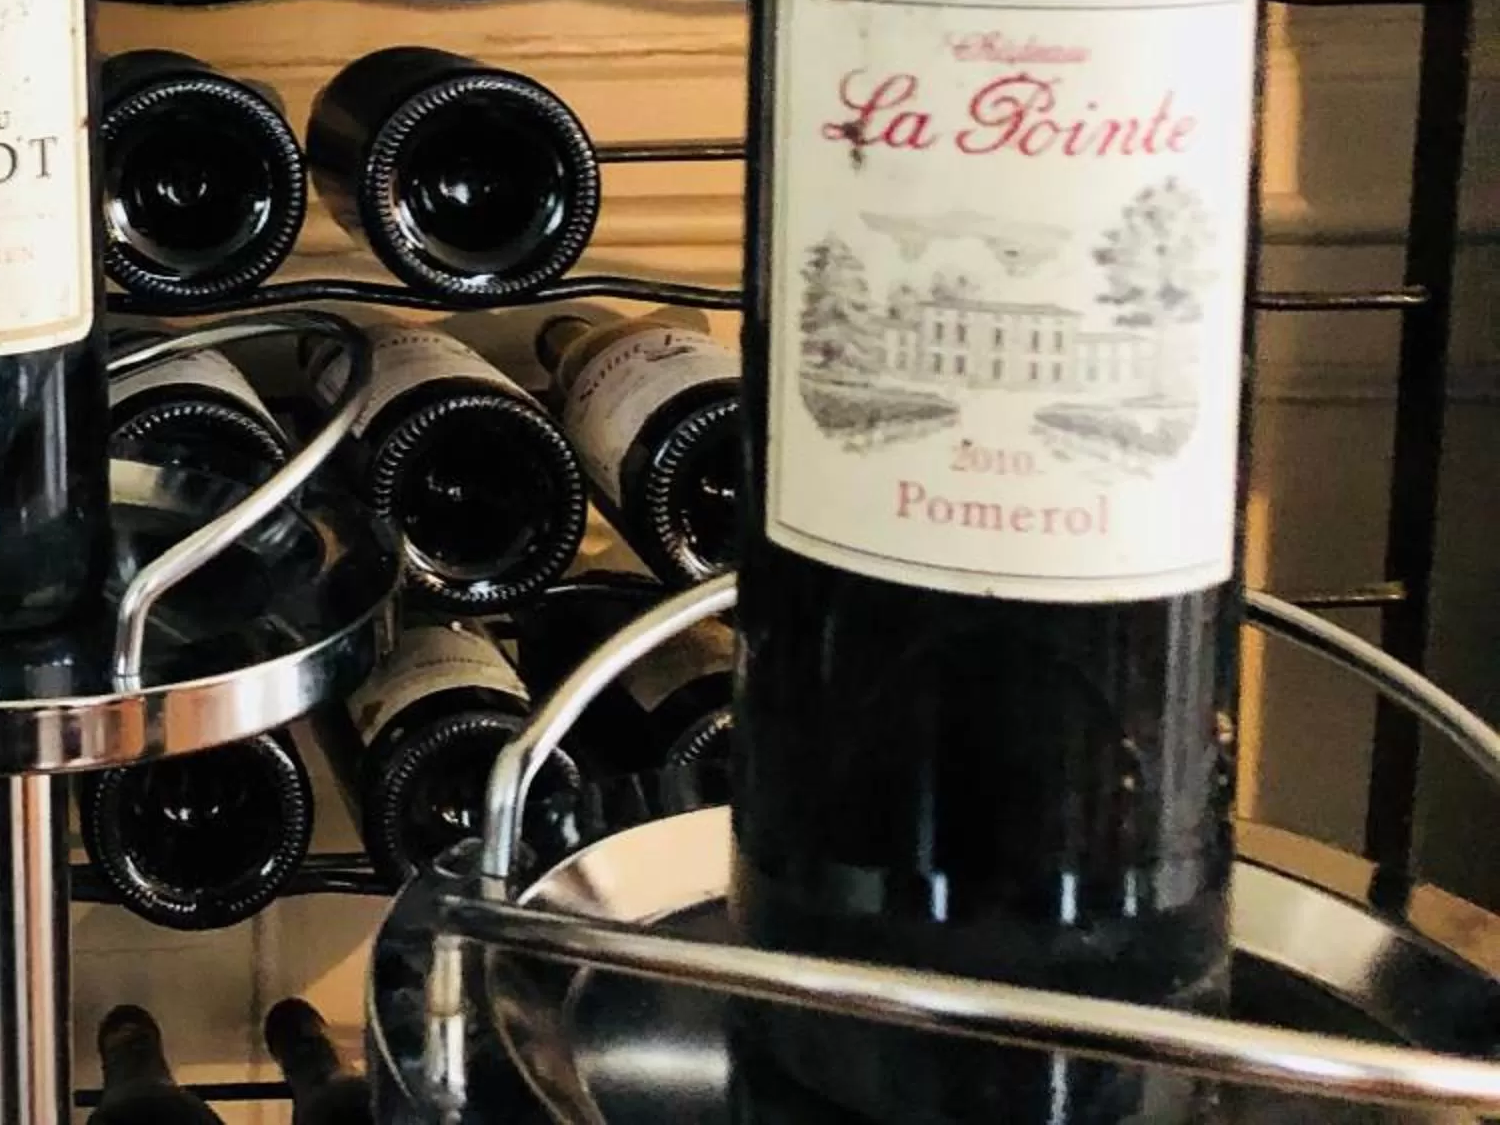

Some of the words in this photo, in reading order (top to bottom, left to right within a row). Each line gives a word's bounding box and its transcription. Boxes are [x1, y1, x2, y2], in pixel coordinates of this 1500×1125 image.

[821, 68, 937, 155] La
[954, 73, 1199, 158] Pointe
[950, 440, 1037, 476] 2010
[894, 478, 1111, 537] Pomerol
